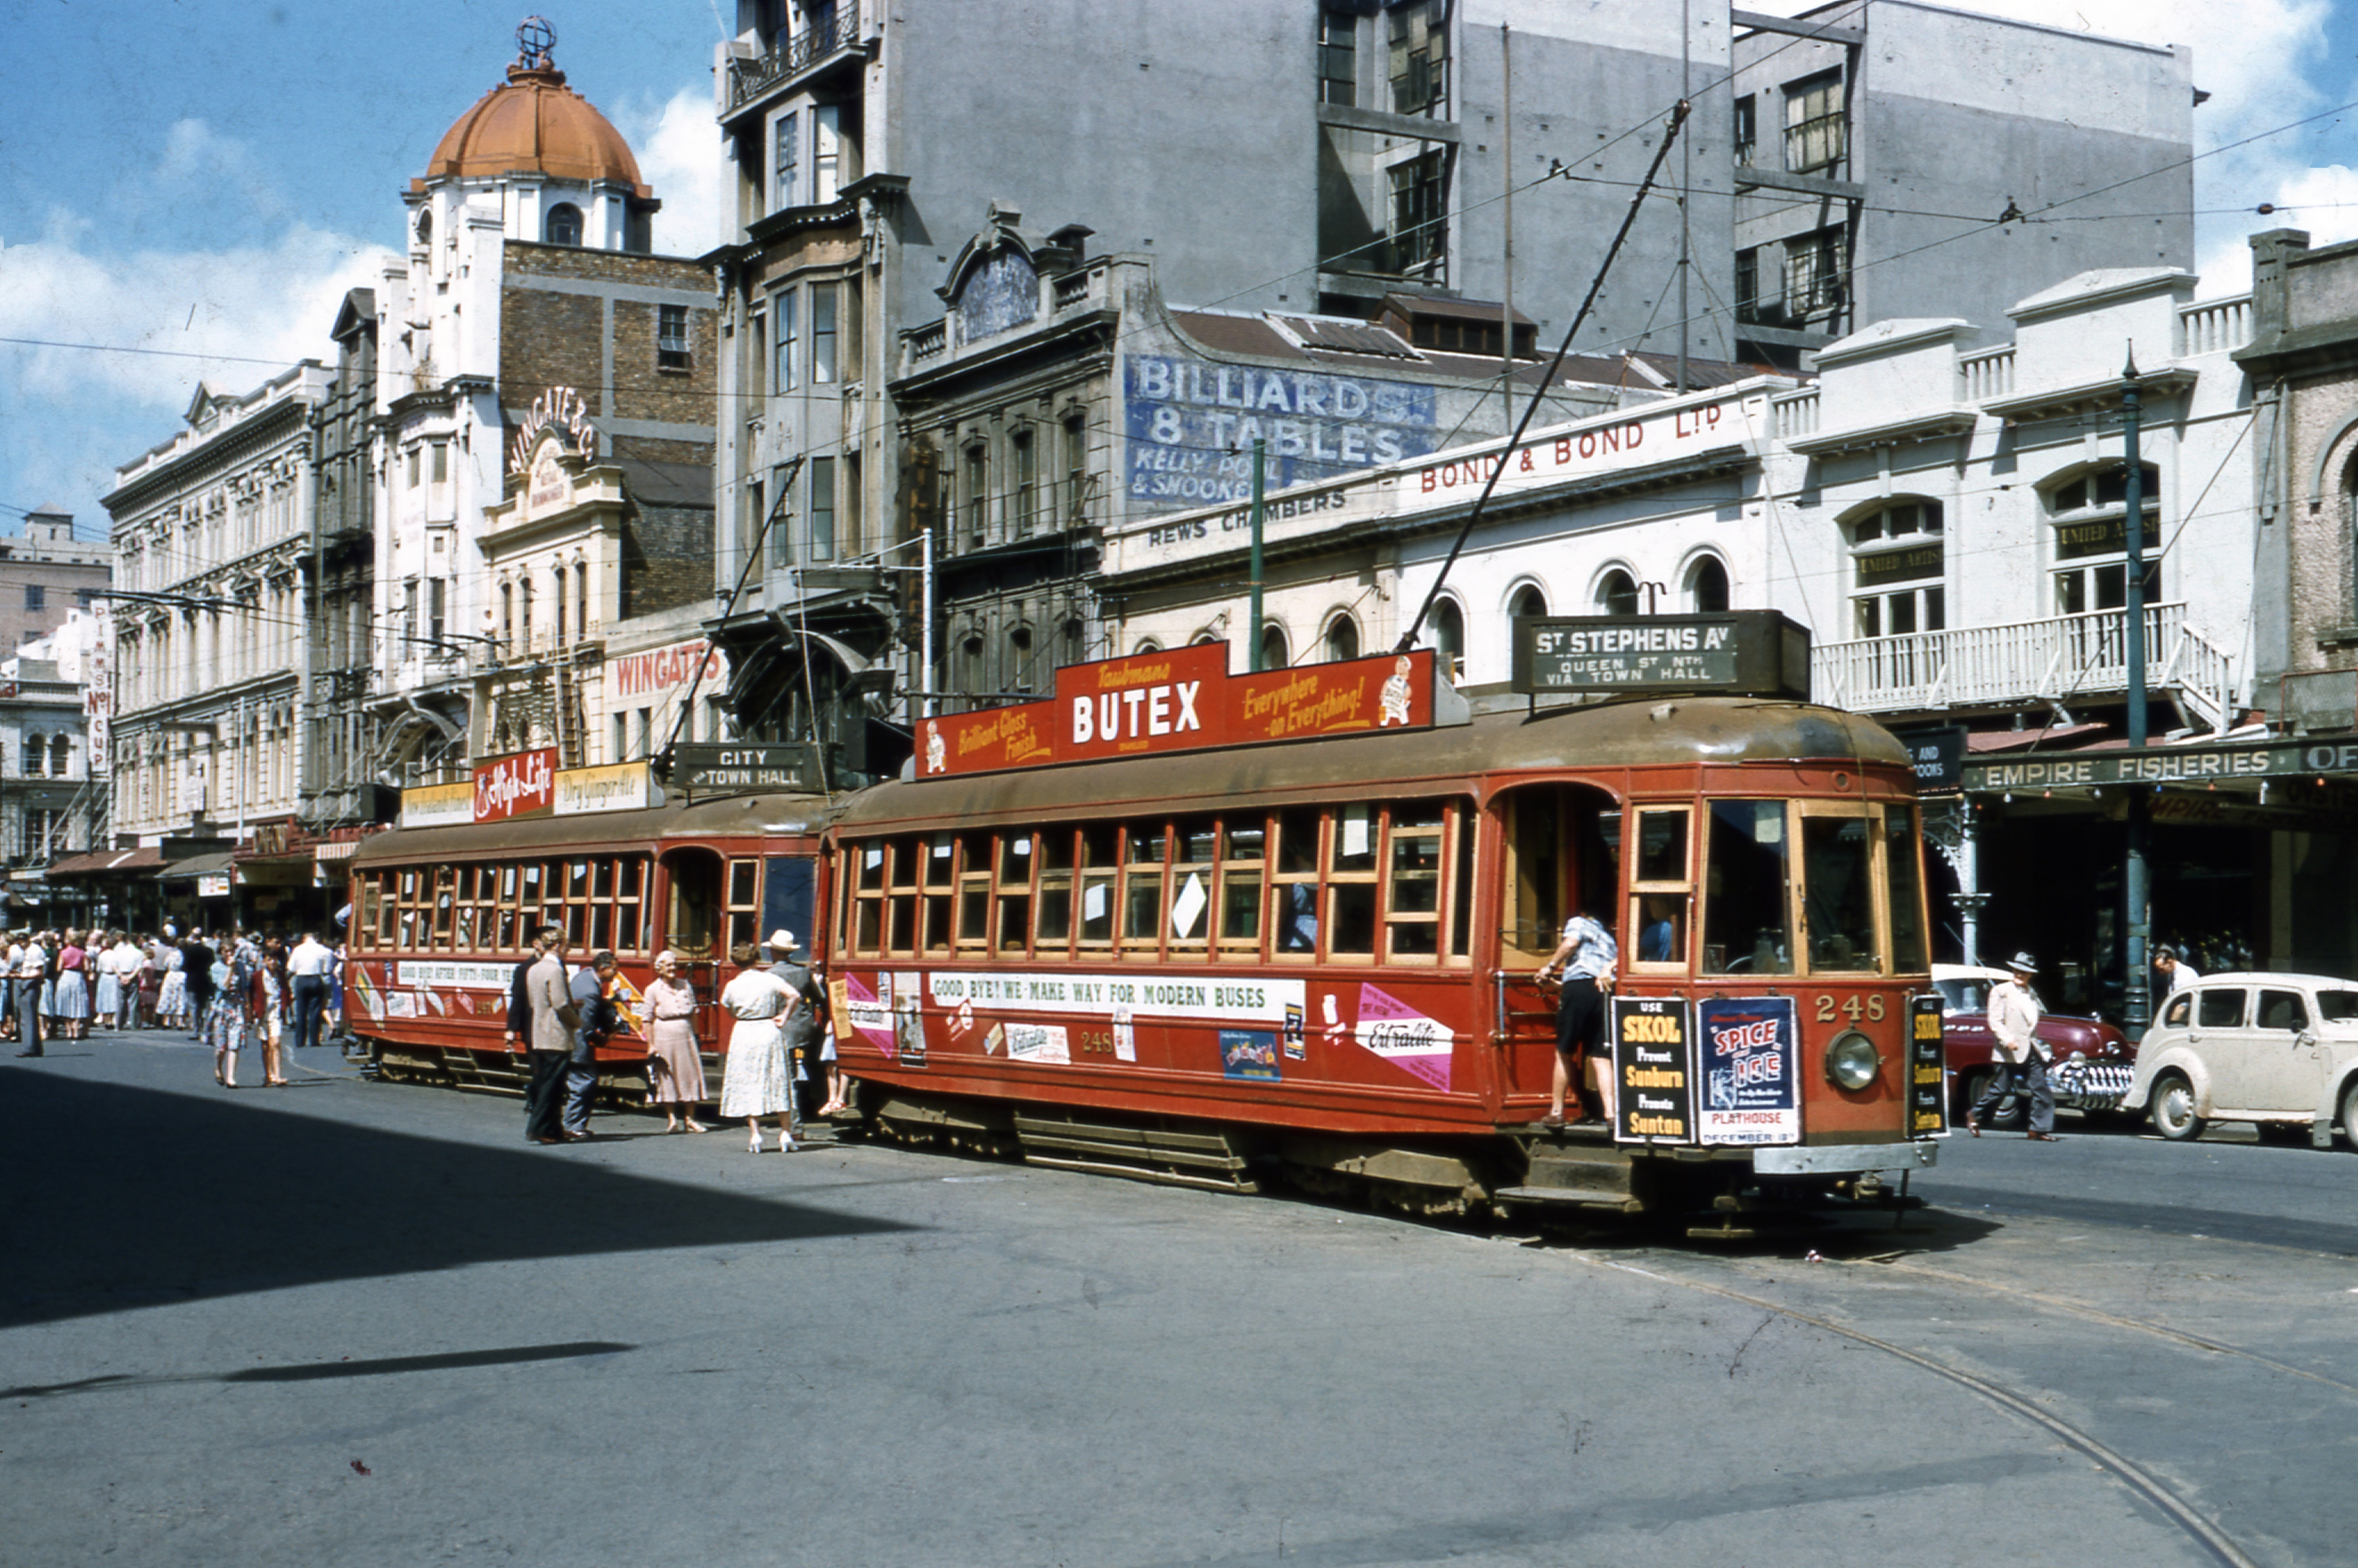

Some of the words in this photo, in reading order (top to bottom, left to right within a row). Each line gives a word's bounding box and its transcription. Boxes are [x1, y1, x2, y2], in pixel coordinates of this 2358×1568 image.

[1139, 358, 1408, 423] BILLIARDS
[510, 386, 575, 473] WINGATE
[1150, 406, 1182, 445] 8
[1206, 411, 1403, 465] TABLES
[1135, 447, 1207, 473] KELLY
[1421, 453, 1499, 493] BOND
[1519, 448, 1535, 472] &
[1555, 421, 1644, 466] BOND
[1132, 473, 1147, 494] &
[1149, 520, 1208, 547] REWS
[1221, 489, 1346, 532] CHMBERS
[2061, 524, 2108, 545] UNITED
[1860, 554, 1901, 574] UNITED
[94, 606, 105, 687] PIMMS
[1535, 632, 1565, 655] ST
[1570, 627, 1700, 654] STEPHENS
[617, 641, 721, 696] WINGATES
[1098, 661, 1171, 688] Taubmans
[1546, 673, 1574, 686] VIA
[1591, 668, 1644, 684] TOWN
[1660, 666, 1712, 681] HALL
[1559, 659, 1626, 674] QUEEN
[1638, 656, 1659, 670] ST
[1244, 672, 1319, 720] Everywhere
[1287, 676, 1365, 733] Everything!
[1073, 679, 1202, 744] BUTEX
[94, 720, 104, 766] CUP
[719, 750, 767, 765] CITY
[1005, 725, 1037, 761] Finish
[1919, 745, 1939, 760] AND
[706, 771, 751, 785] TOWN
[757, 770, 801, 784] HALL
[2119, 751, 2270, 780] FISHERIES
[487, 759, 520, 816] High
[519, 752, 552, 805] Life
[563, 774, 582, 810] Dry
[617, 768, 634, 796] Ale
[2148, 796, 2227, 820] MPIRE
[934, 979, 964, 997] GOOD
[970, 980, 999, 999] BYE!
[1004, 981, 1023, 999] WE
[1029, 982, 1065, 1001] MAKE
[1073, 983, 1102, 1003] WAY
[1109, 984, 1135, 1003] FOR
[1143, 984, 1207, 1006] MODERN
[1214, 987, 1266, 1008] BUSES
[1640, 1002, 1664, 1013] USE
[1816, 994, 1886, 1023] 248
[1622, 1015, 1682, 1044] SKOL
[1636, 1046, 1673, 1063] Prevent
[1625, 1064, 1684, 1089] Sunburn
[1629, 1111, 1684, 1136] Suntan
[1703, 1133, 1772, 1143] DECEMBER
